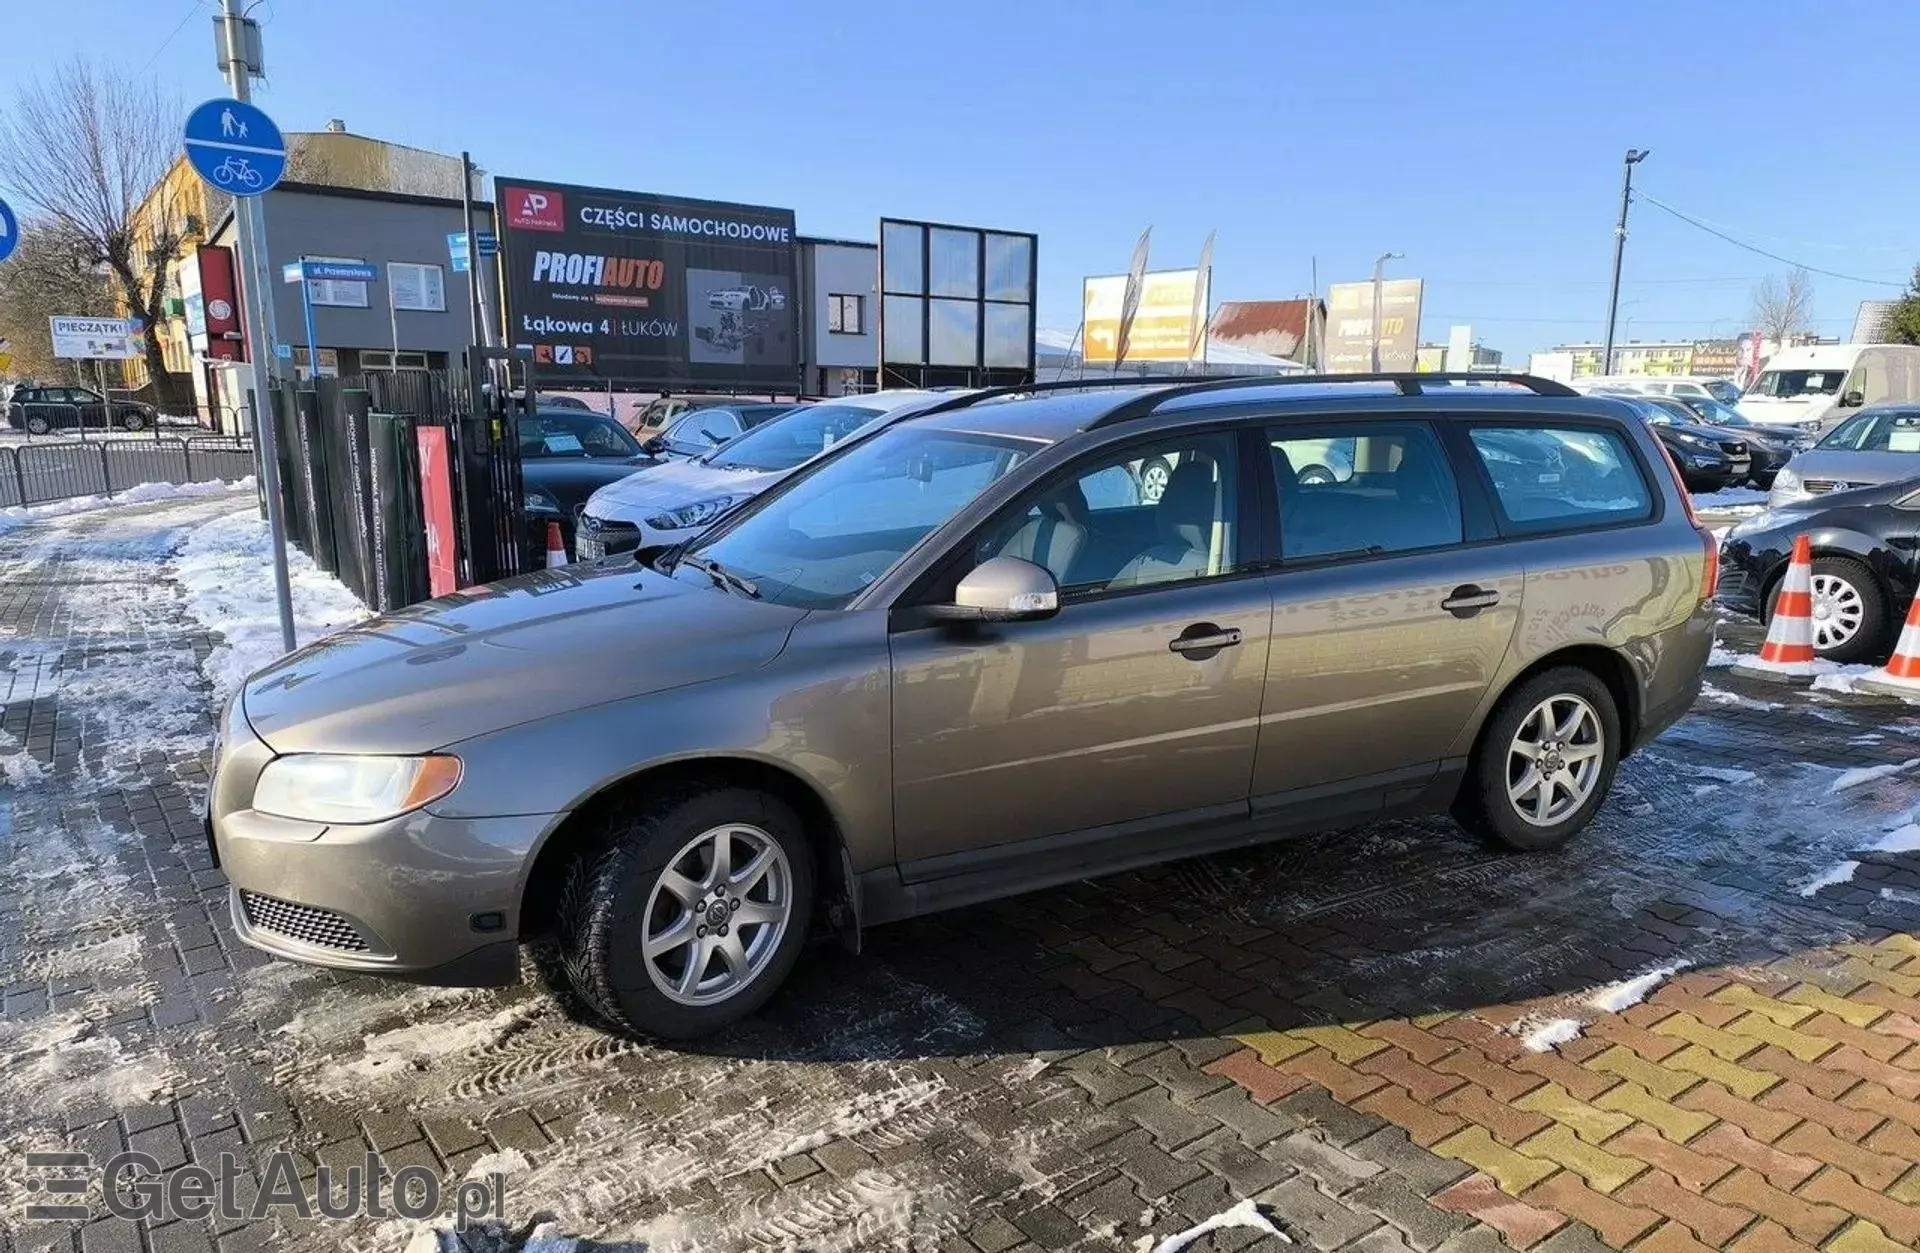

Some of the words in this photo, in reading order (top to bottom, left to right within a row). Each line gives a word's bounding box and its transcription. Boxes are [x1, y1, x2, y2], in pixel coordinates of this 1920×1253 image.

[580, 206, 644, 230] CZĘŚCI
[651, 213, 790, 244] SAMOCHODOWE
[533, 251, 665, 290] PROFIAUTO
[58, 322, 123, 336] PIECZĄTKI
[523, 315, 594, 336] Łąkowa
[600, 319, 611, 335] 4
[621, 318, 679, 337] ŁUKÓW
